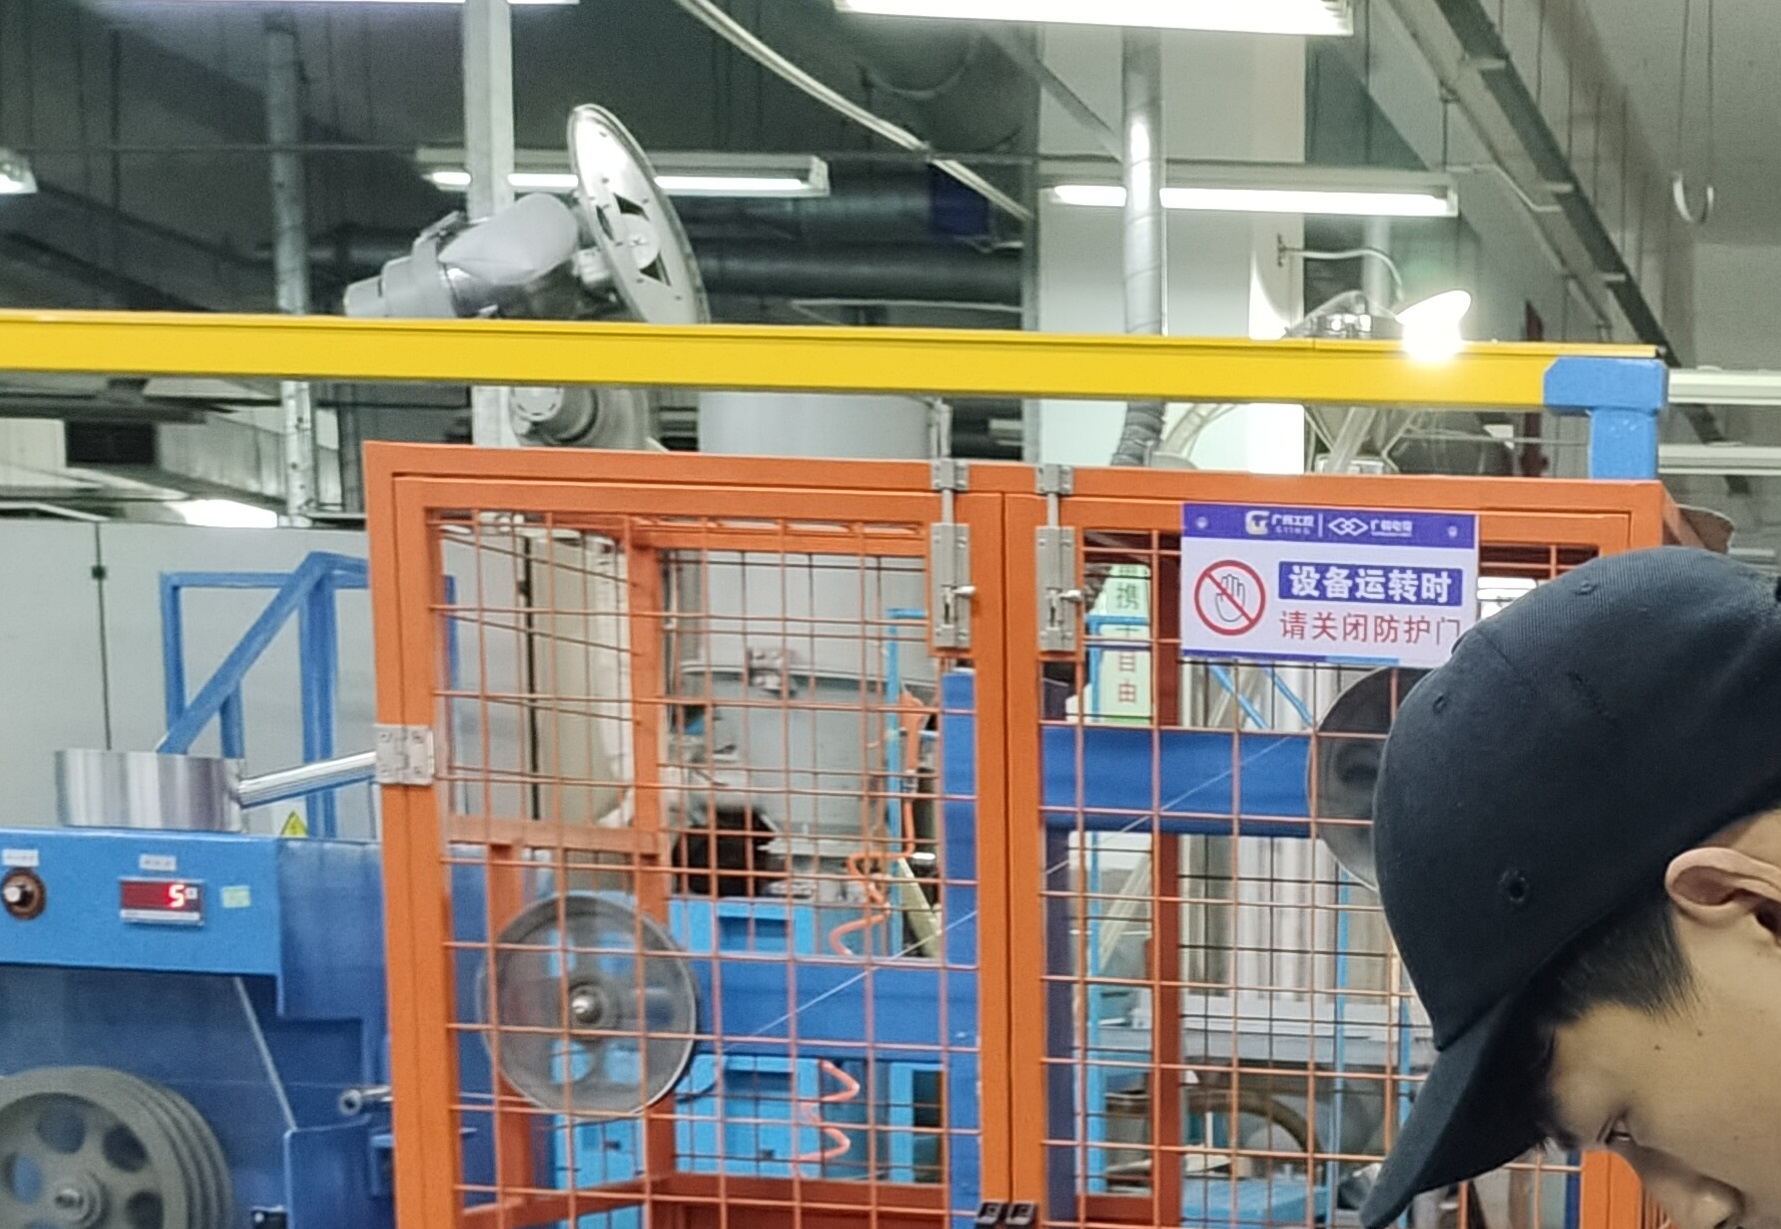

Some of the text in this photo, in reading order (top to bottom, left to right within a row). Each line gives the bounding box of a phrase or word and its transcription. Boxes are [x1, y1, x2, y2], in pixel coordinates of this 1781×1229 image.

[1289, 564, 1452, 603] 设备运转时
[1280, 610, 1461, 645] 请关闭防护门
